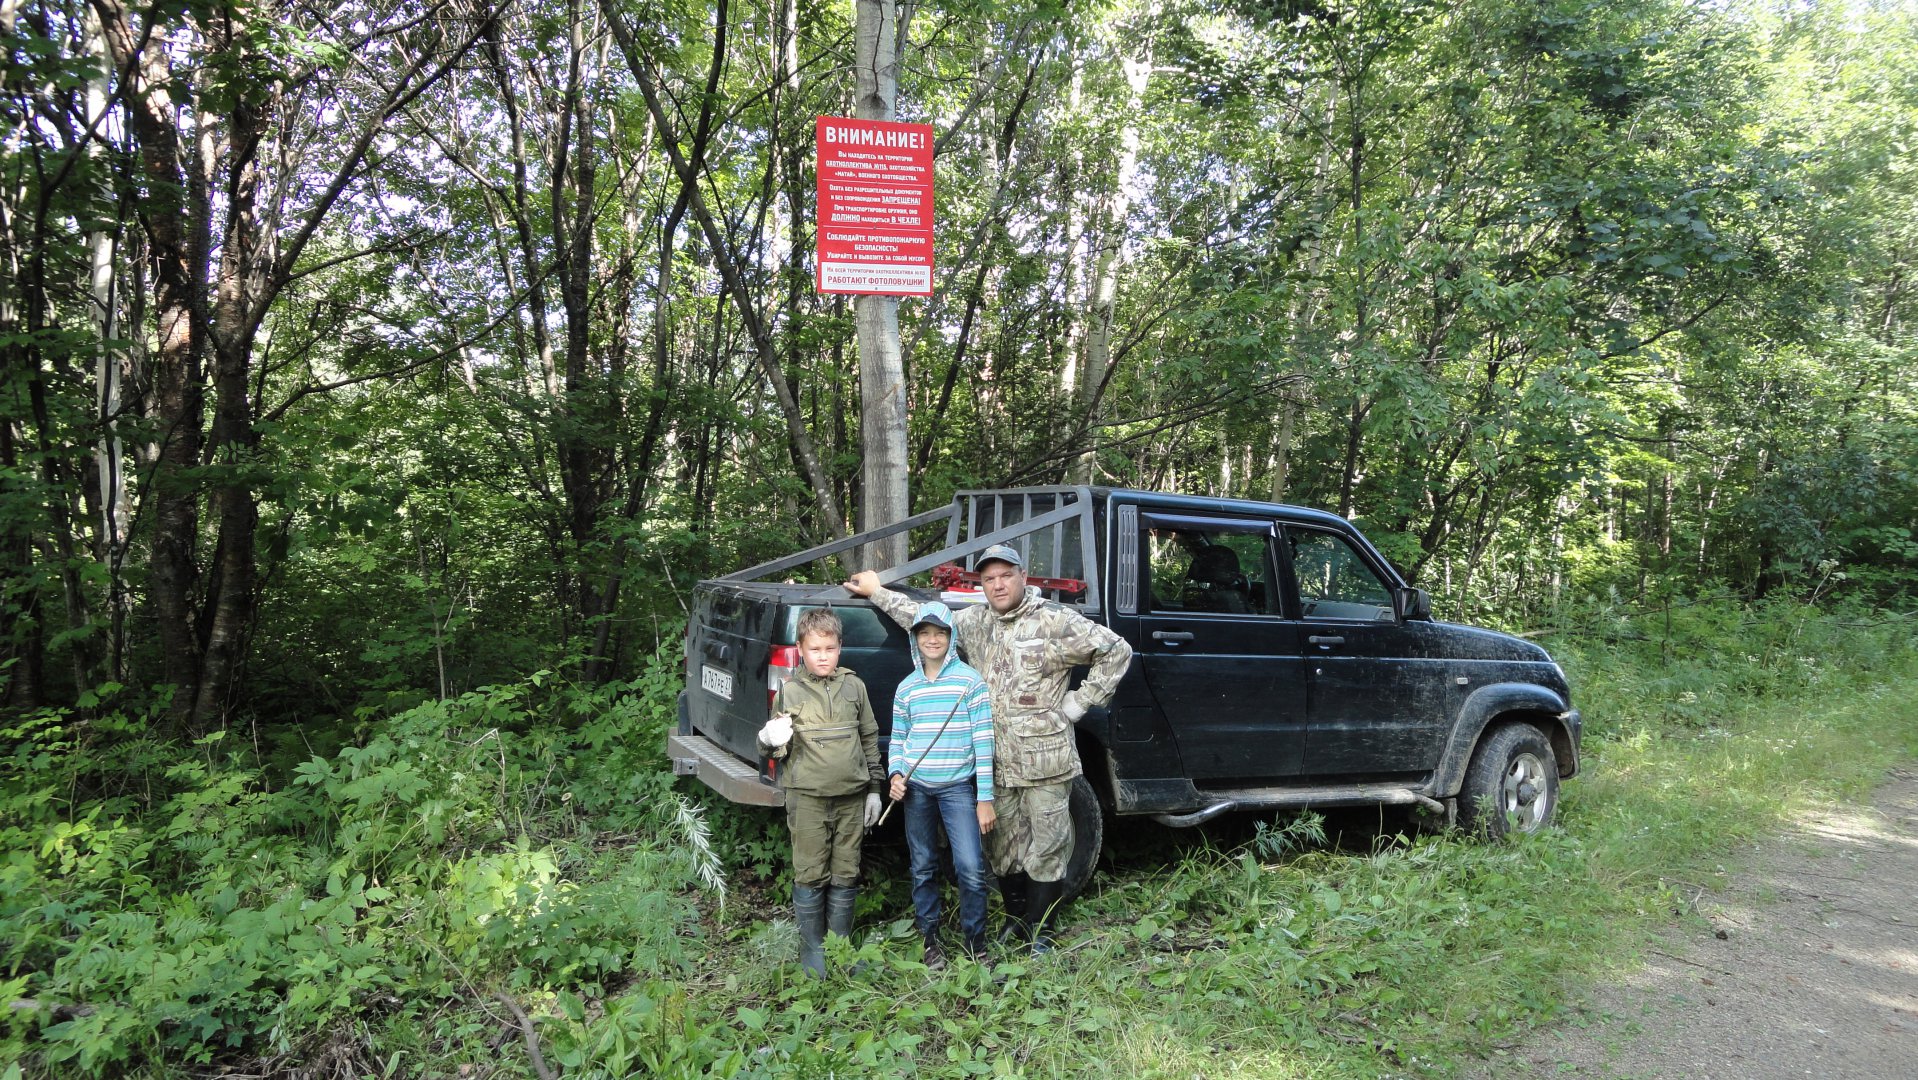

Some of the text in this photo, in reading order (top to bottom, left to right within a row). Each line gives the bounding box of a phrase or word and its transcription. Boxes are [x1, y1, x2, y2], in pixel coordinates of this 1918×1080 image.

[826, 126, 925, 149] ВНИМАНИЕ!
[838, 150, 846, 158] ВЫ
[848, 152, 876, 160] НАХОДИТЕСЬ
[882, 196, 920, 205] ЗАПРЕЩЕНА!
[831, 213, 860, 222] ДОЛЖНО
[897, 217, 920, 225] ЧЕХЛЕ!
[826, 232, 925, 244] СОБЛЮДАЙТЕ ПРОТИВОПОЖАРНУЮ
[855, 244, 898, 252] БЕЗОПАСНОСТЬ!
[826, 251, 852, 260] УБИРАЙТЕ
[827, 275, 925, 286] РАБОТАЮТ ФОТОЛОВУШКИ!
